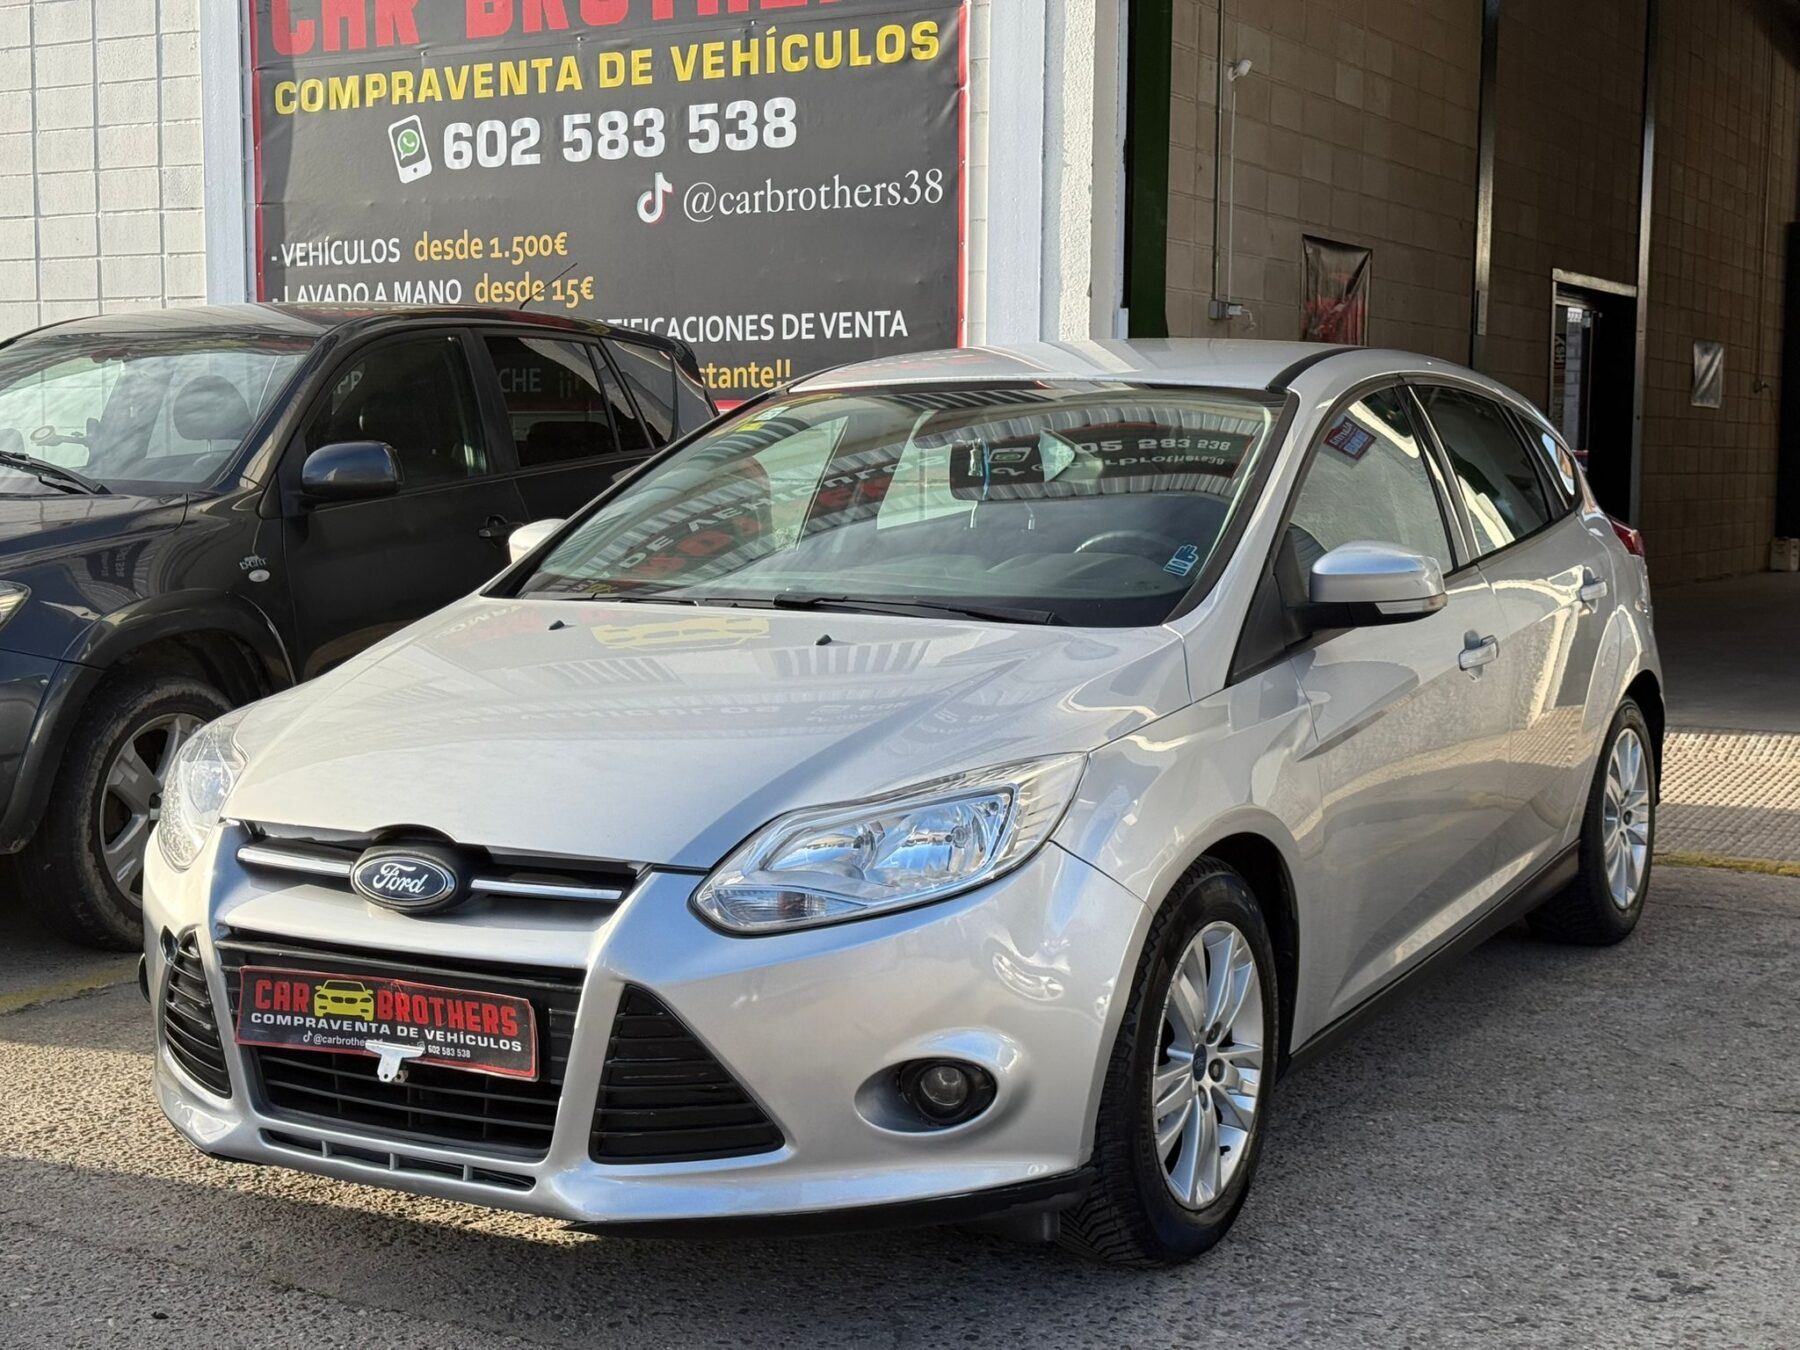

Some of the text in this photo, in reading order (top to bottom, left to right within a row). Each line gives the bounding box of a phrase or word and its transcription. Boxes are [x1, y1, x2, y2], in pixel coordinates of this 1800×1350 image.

[274, 55, 583, 115] COMPRAVENTA
[598, 48, 654, 89] DE
[670, 20, 941, 82] VEHÍCULOS
[443, 96, 797, 170] 602 583 538
[683, 168, 944, 223] @carbrothers38
[281, 234, 401, 268] VEHÍCULOS
[415, 229, 483, 262] desde
[490, 231, 568, 266] 1.500€
[394, 279, 463, 306] MANO
[474, 271, 545, 304] desde
[553, 276, 595, 309] 15€
[781, 312, 816, 340] DE
[819, 309, 909, 339] VENTA
[372, 862, 429, 894] Ford
[254, 979, 521, 1037] CAR BROTHERS
[250, 1012, 523, 1052] COMPRAVENTA DE VEHÍCULOS
[441, 1045, 456, 1057] 583
[456, 1046, 472, 1059] 538
